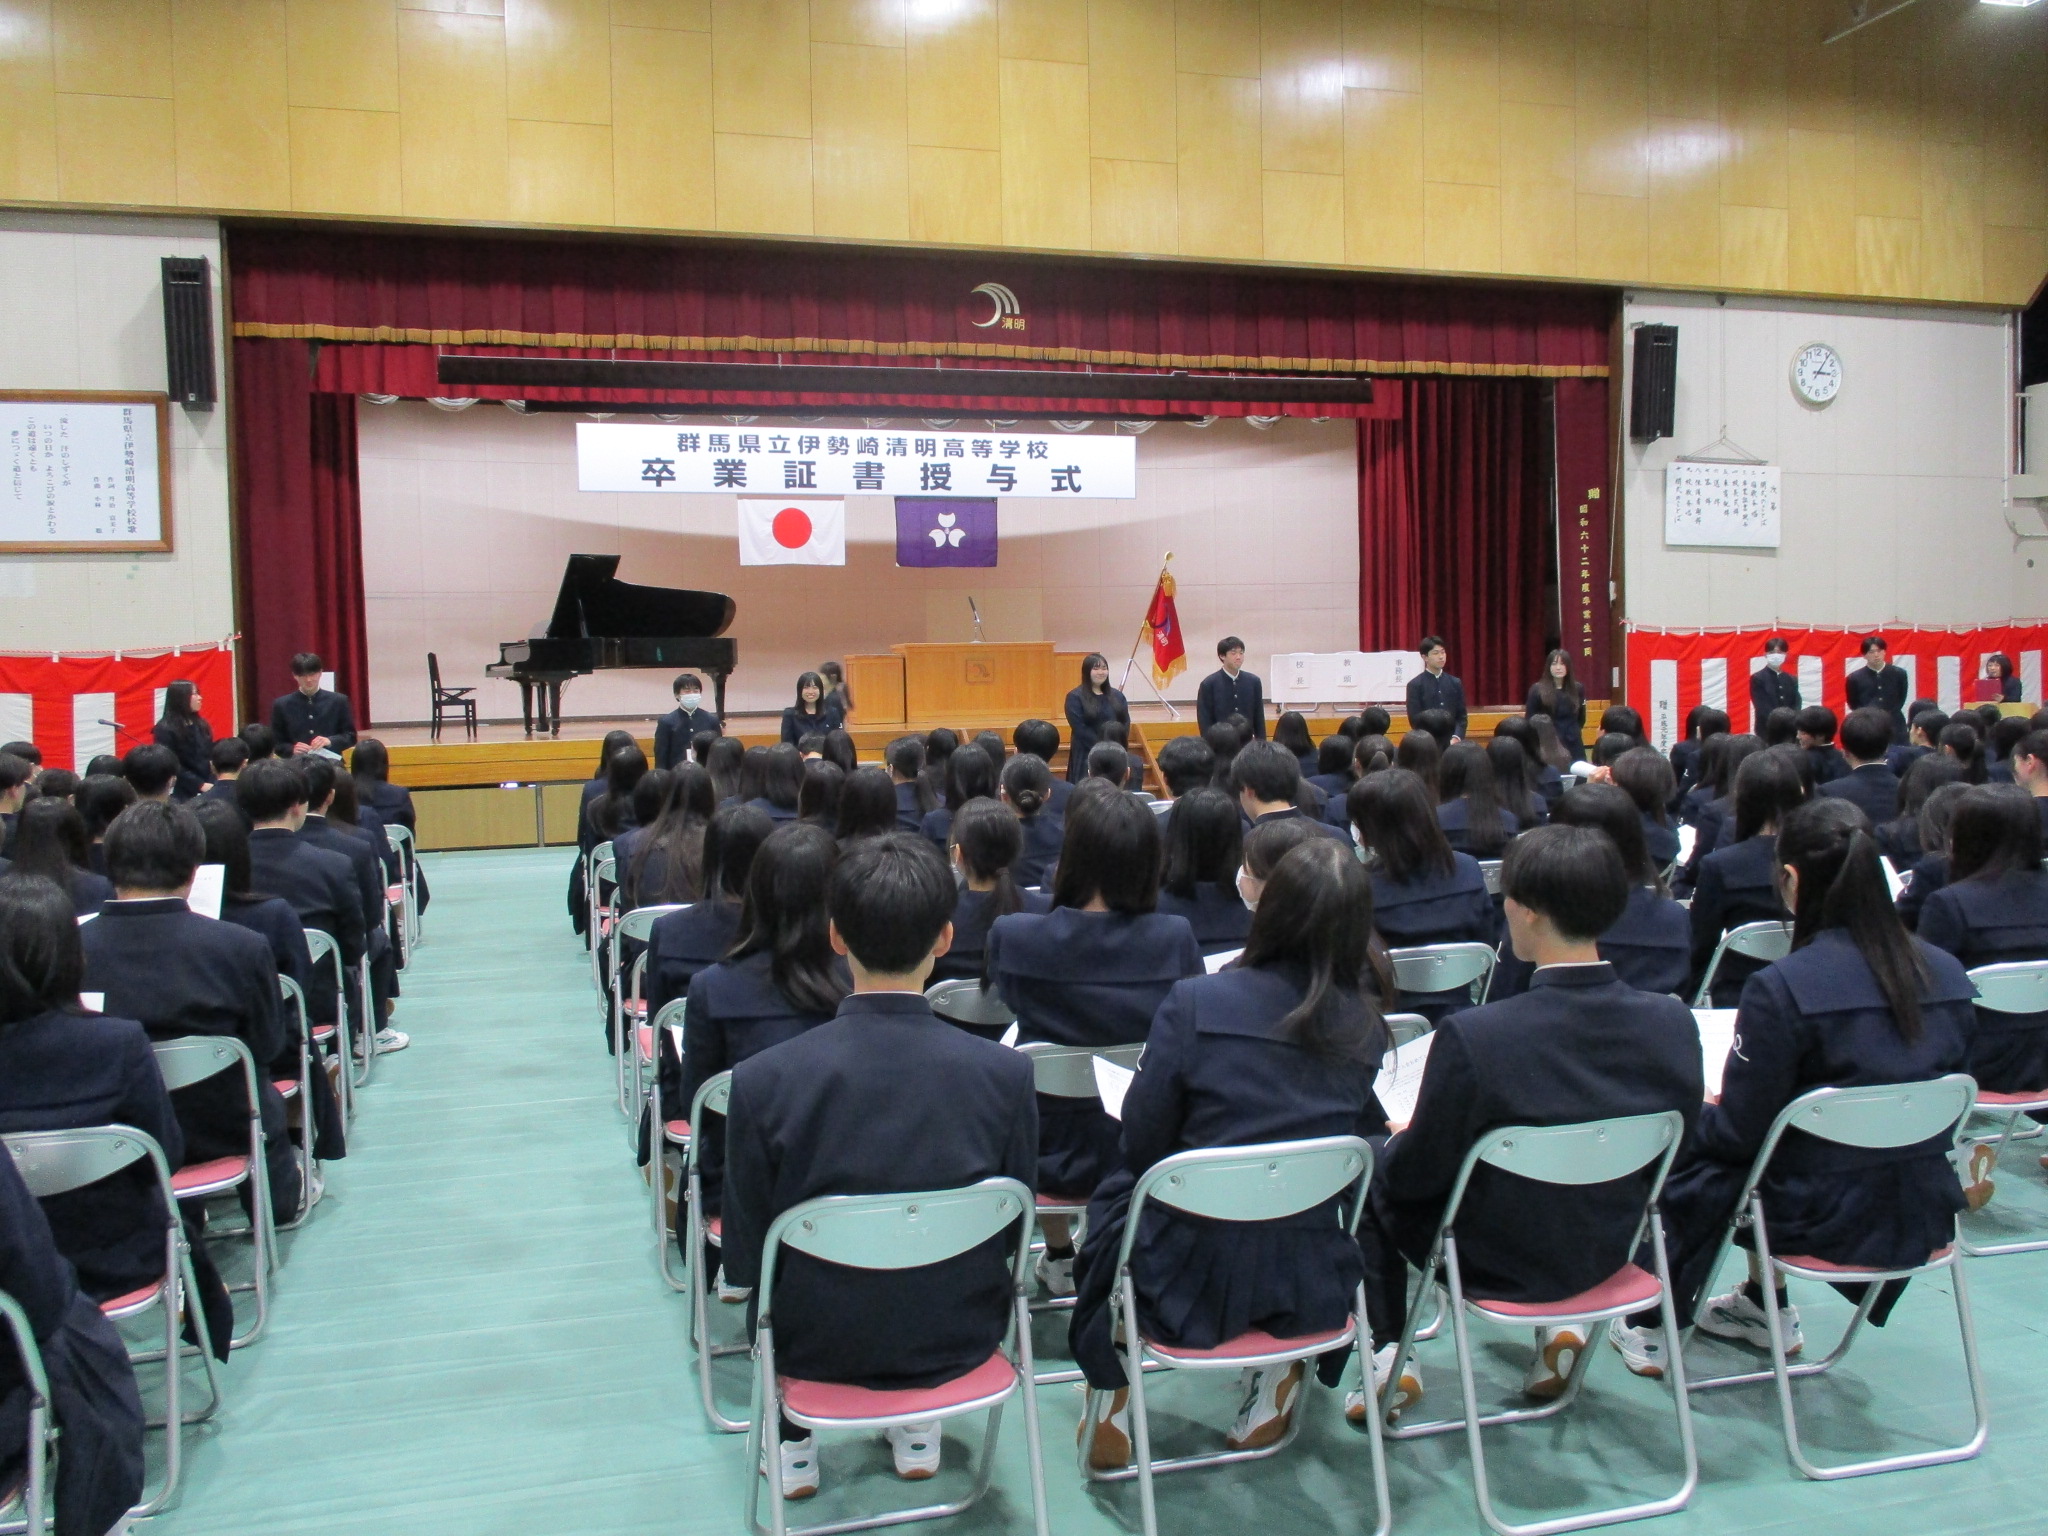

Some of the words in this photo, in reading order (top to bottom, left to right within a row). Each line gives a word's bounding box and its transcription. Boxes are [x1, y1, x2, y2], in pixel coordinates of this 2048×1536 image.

[1001, 317, 1026, 330] 清明
[1813, 348, 1822, 357] 12
[1800, 359, 1808, 367] 10
[1830, 359, 1835, 367] 2
[1797, 368, 1803, 376] 9
[1800, 378, 1806, 387] 8
[1829, 379, 1834, 388] 4
[1807, 386, 1813, 395] 7
[1815, 389, 1820, 397] 6
[1823, 386, 1829, 395] 5
[676, 433, 1050, 460] 群馬県立伊勢崎清明高等学校
[641, 457, 1083, 493] 卒業証書授与式
[1587, 487, 1600, 500] 贈
[1579, 503, 1592, 657] 昭和六十二年度卒業生一同
[1295, 660, 1304, 686] 校長
